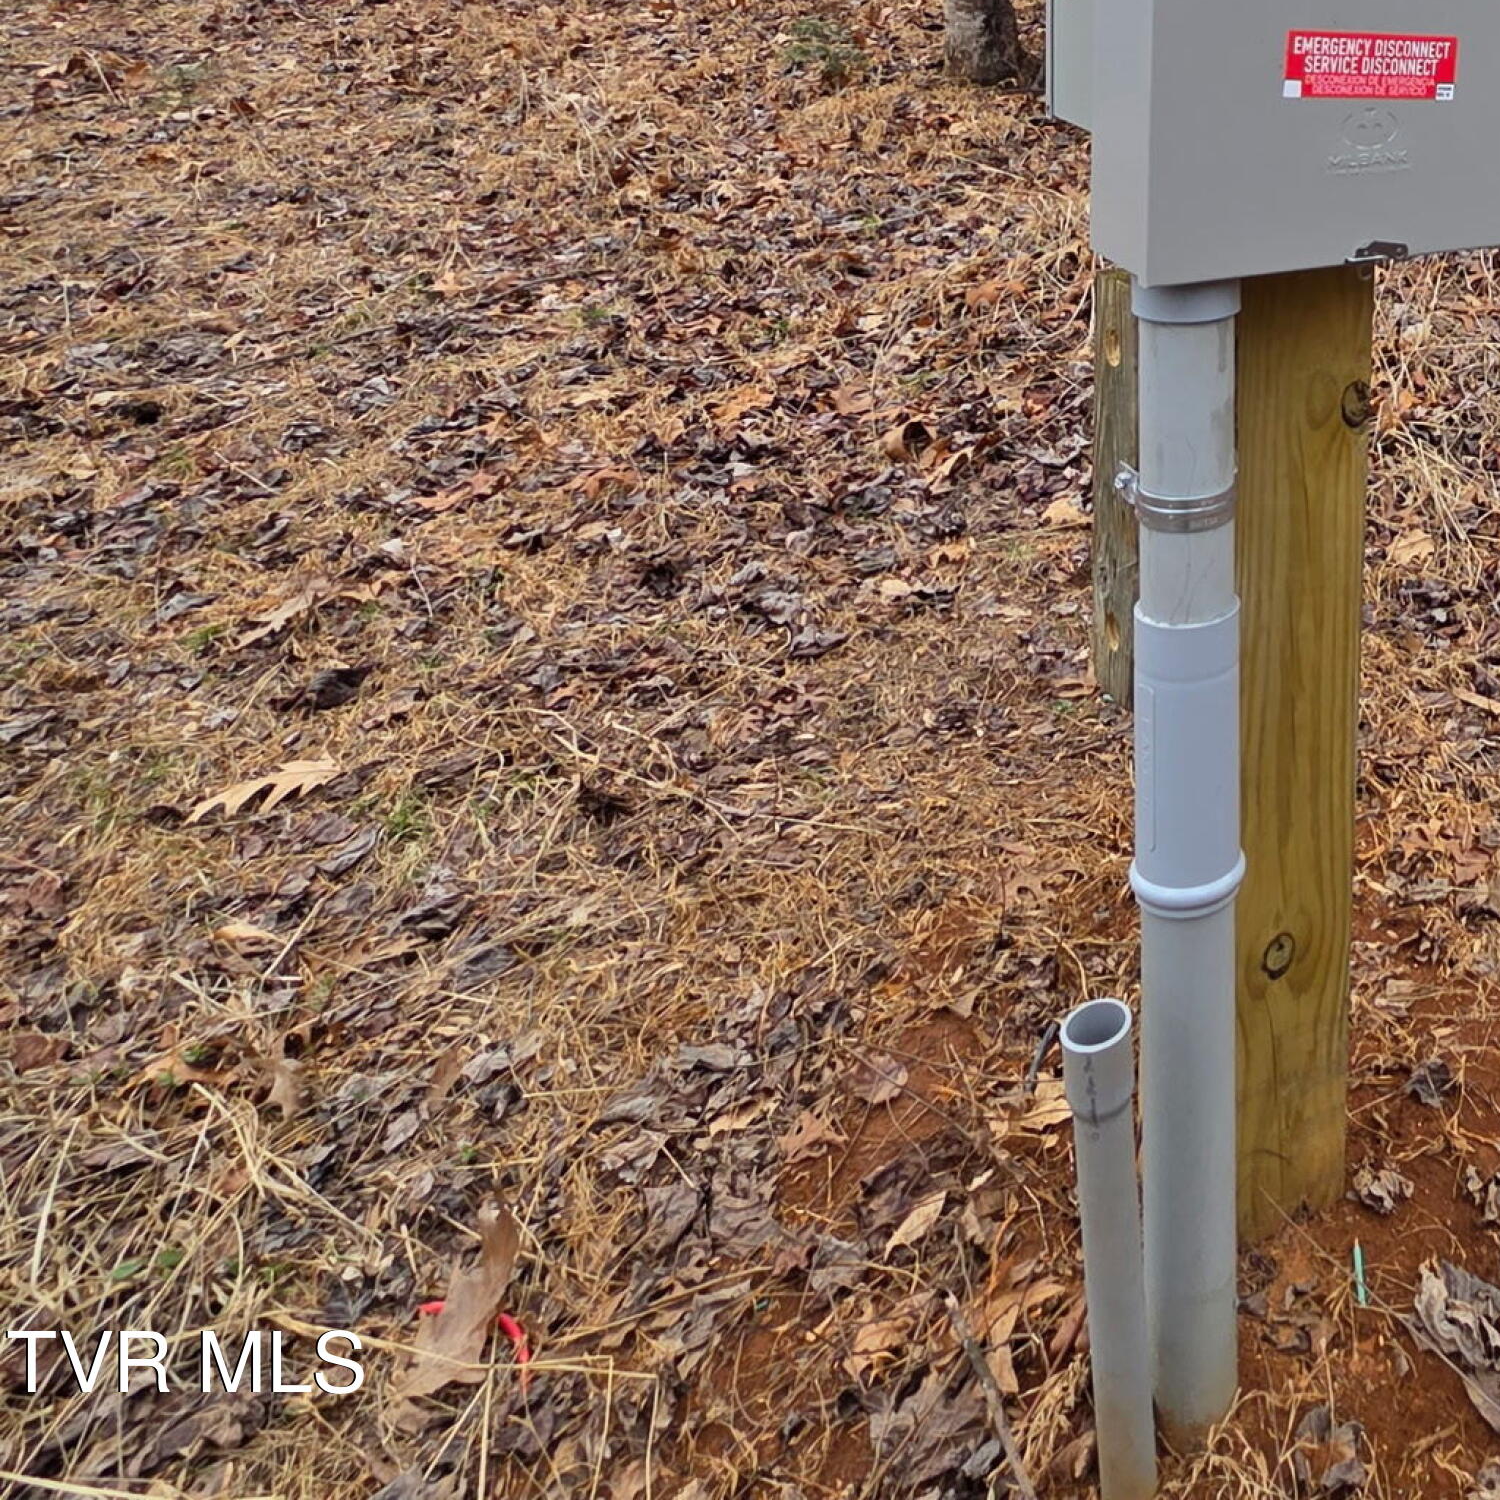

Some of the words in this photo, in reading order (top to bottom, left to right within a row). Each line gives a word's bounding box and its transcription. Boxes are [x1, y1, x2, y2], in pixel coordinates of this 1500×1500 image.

[1294, 36, 1371, 56] EMERGENCY
[1374, 39, 1451, 59] DISCONNECT
[1304, 55, 1359, 74] SERVICE
[1361, 57, 1439, 76] DISCONNECT
